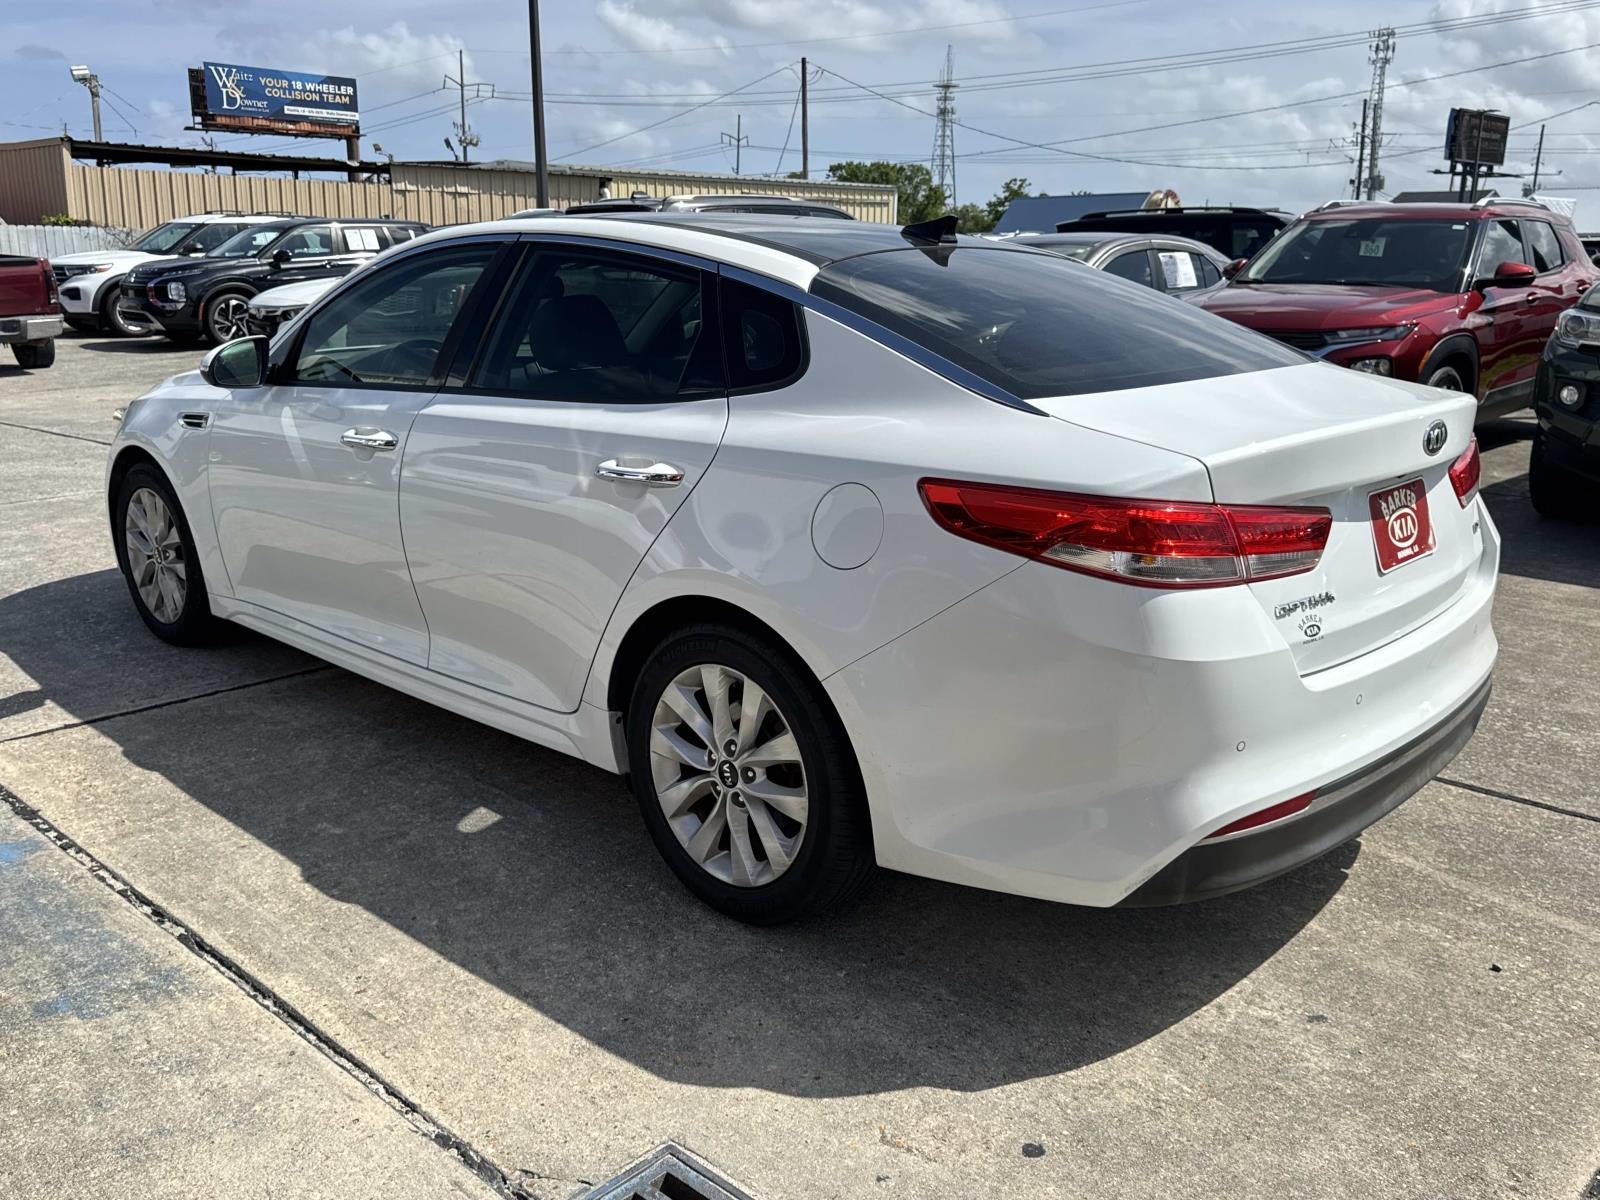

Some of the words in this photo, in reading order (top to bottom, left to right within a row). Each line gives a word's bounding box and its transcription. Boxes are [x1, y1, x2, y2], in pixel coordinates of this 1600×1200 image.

[208, 66, 253, 88] Waitz
[259, 77, 288, 88] YOUR
[291, 80, 303, 90] 18
[305, 82, 354, 95] WHEELER
[220, 87, 269, 109] Downer
[265, 87, 320, 102] COLLISION
[321, 94, 350, 104] TEAM
[1428, 427, 1446, 450] KIA
[1379, 488, 1417, 521] BARKER
[1392, 515, 1415, 540] KIA
[1297, 614, 1323, 631] BARKER
[1305, 624, 1320, 637] KIA
[722, 763, 732, 786] KIA
